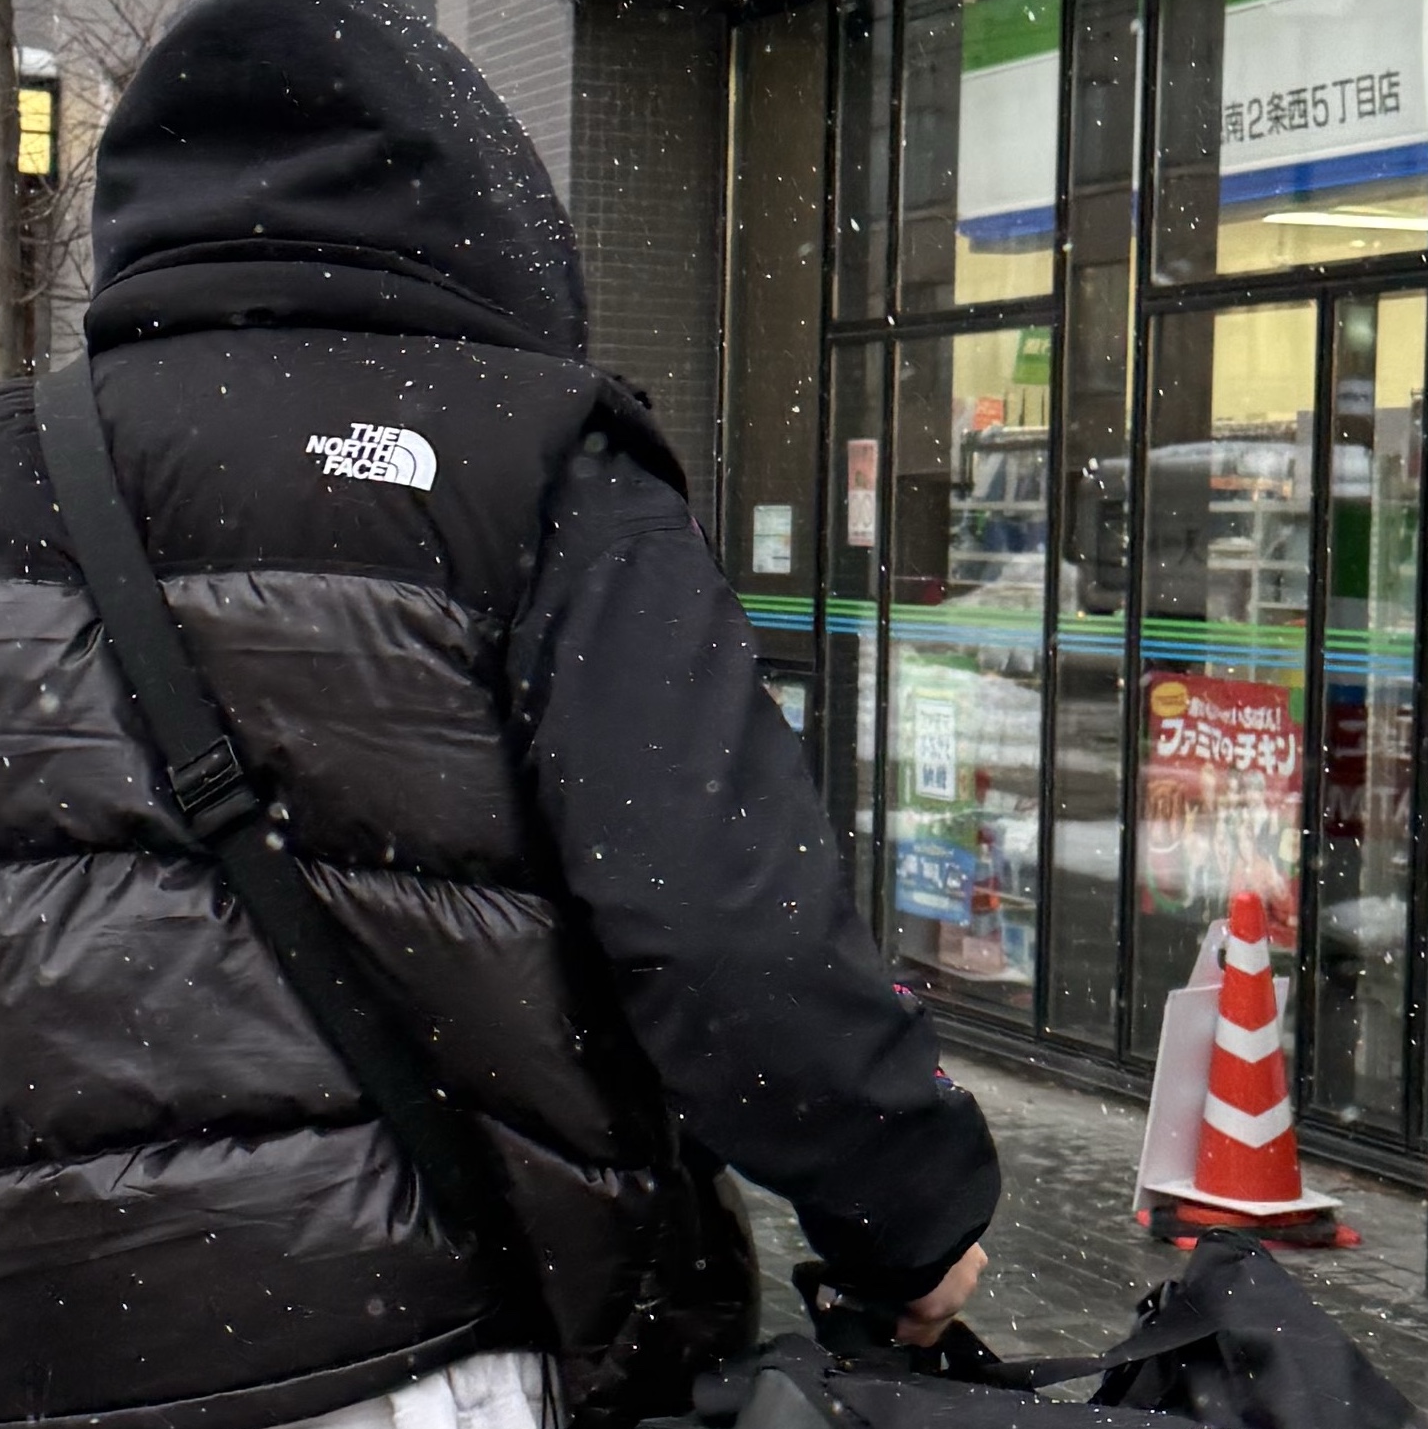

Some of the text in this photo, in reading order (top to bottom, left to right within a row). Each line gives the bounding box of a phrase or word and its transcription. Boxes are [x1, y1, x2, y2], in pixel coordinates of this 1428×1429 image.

[1221, 68, 1401, 145] 南2条西5丁目店
[350, 422, 401, 445] THE
[305, 434, 395, 463] NORTH
[322, 456, 390, 482] FACE
[1156, 718, 1297, 777] ファミマのチキン
